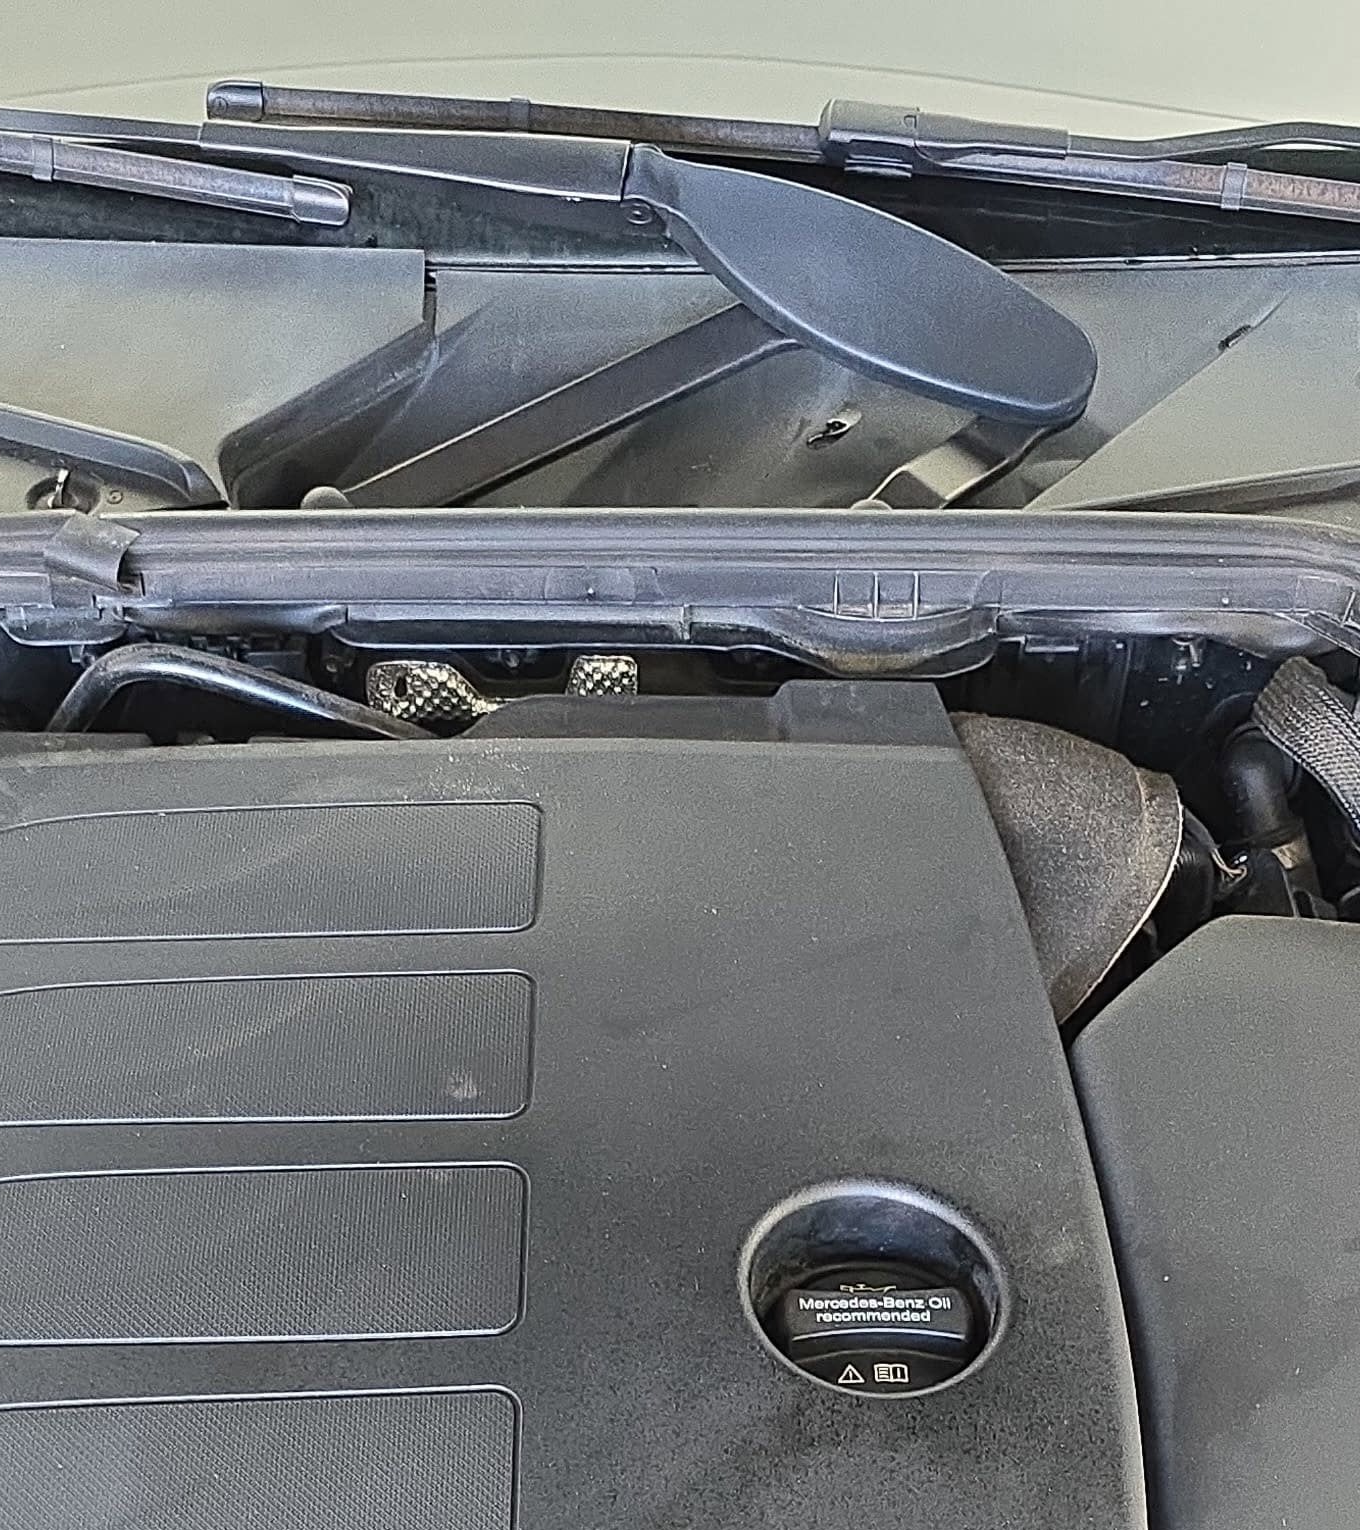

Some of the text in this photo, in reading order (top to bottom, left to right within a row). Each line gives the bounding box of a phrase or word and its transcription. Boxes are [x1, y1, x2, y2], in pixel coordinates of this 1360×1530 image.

[798, 1297, 951, 1310] Mercedes-Benz Oil
[815, 1309, 931, 1323] recommended
